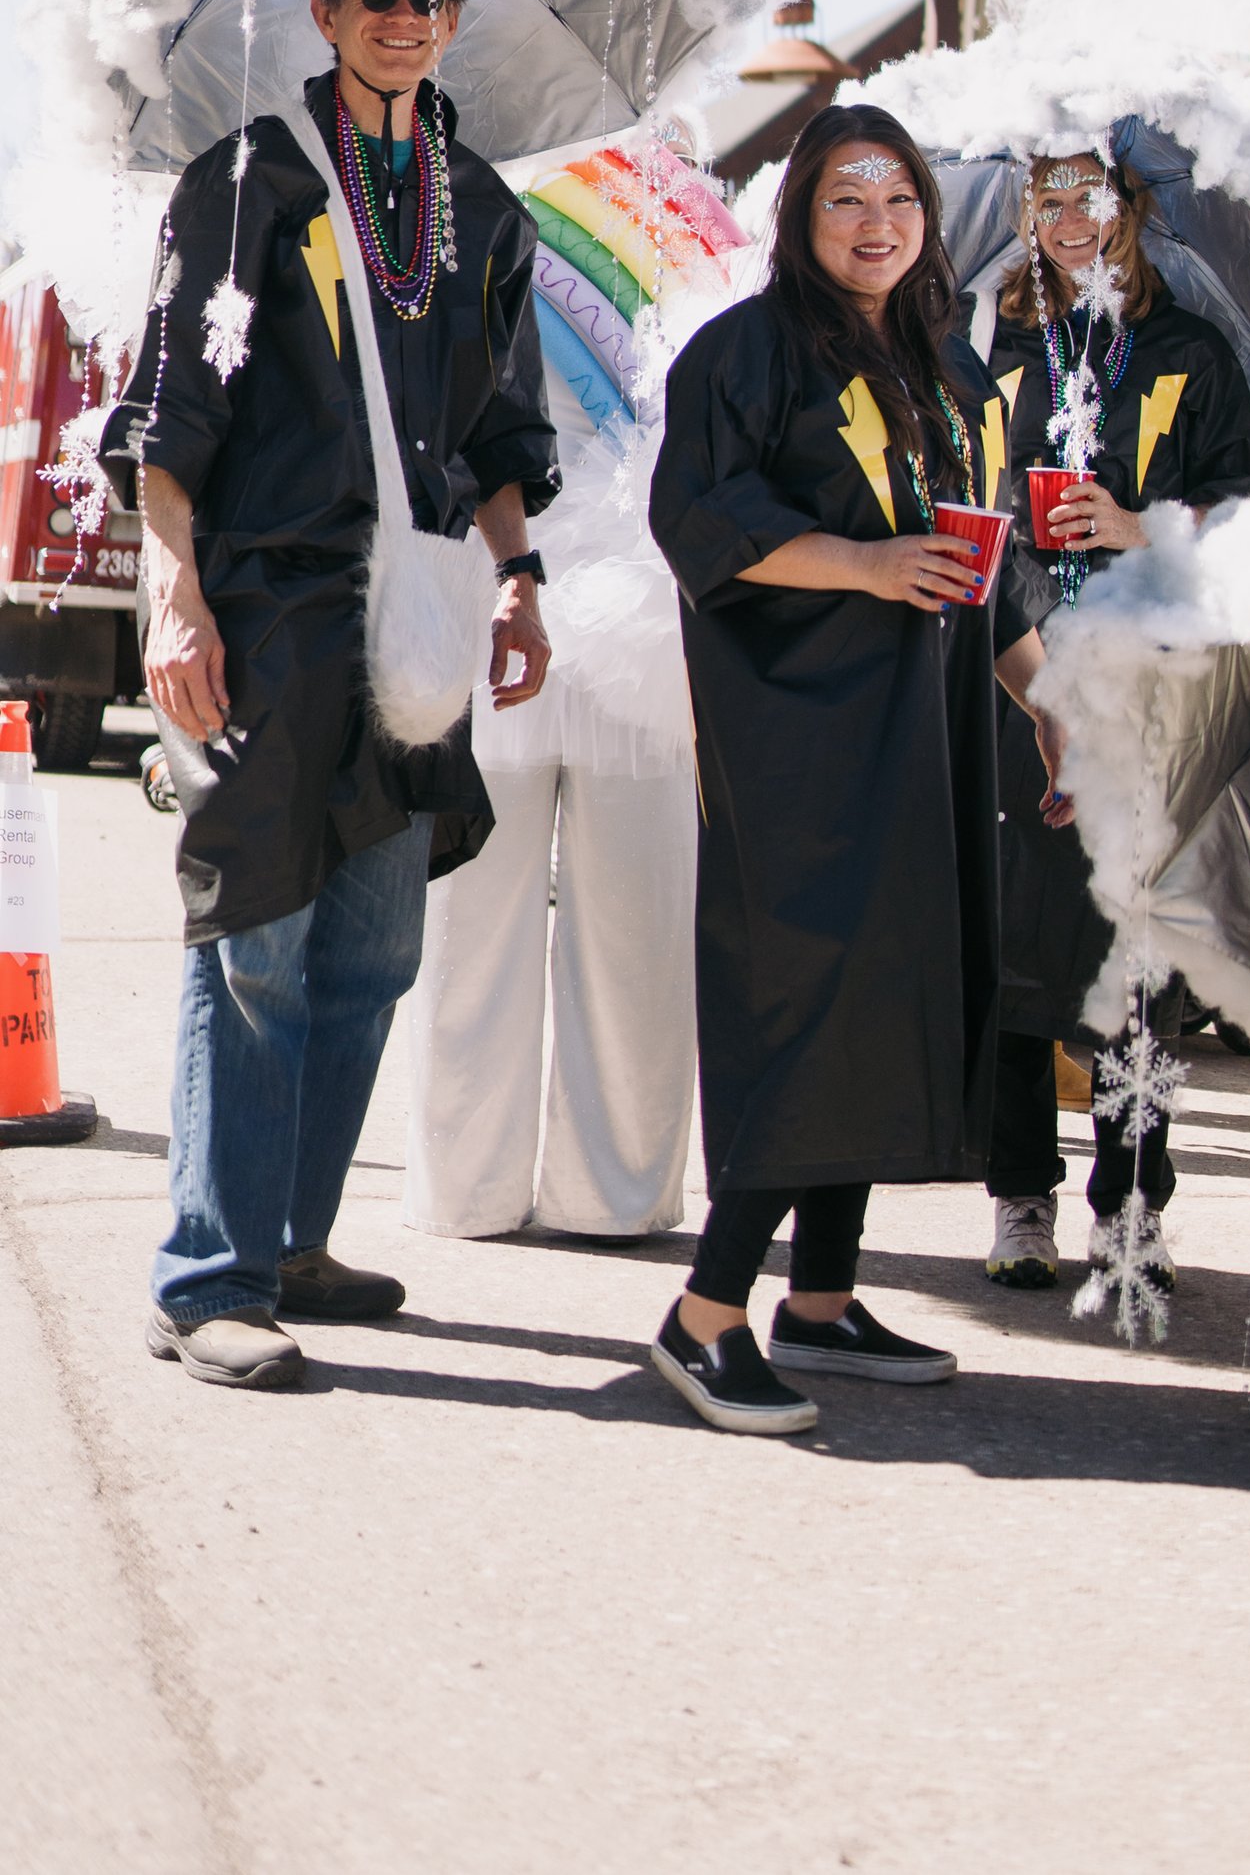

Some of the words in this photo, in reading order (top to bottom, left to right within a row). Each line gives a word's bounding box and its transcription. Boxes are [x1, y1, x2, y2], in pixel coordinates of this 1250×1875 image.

[95, 549, 141, 579] 236
[0, 850, 36, 868] Group
[7, 896, 25, 906] #23
